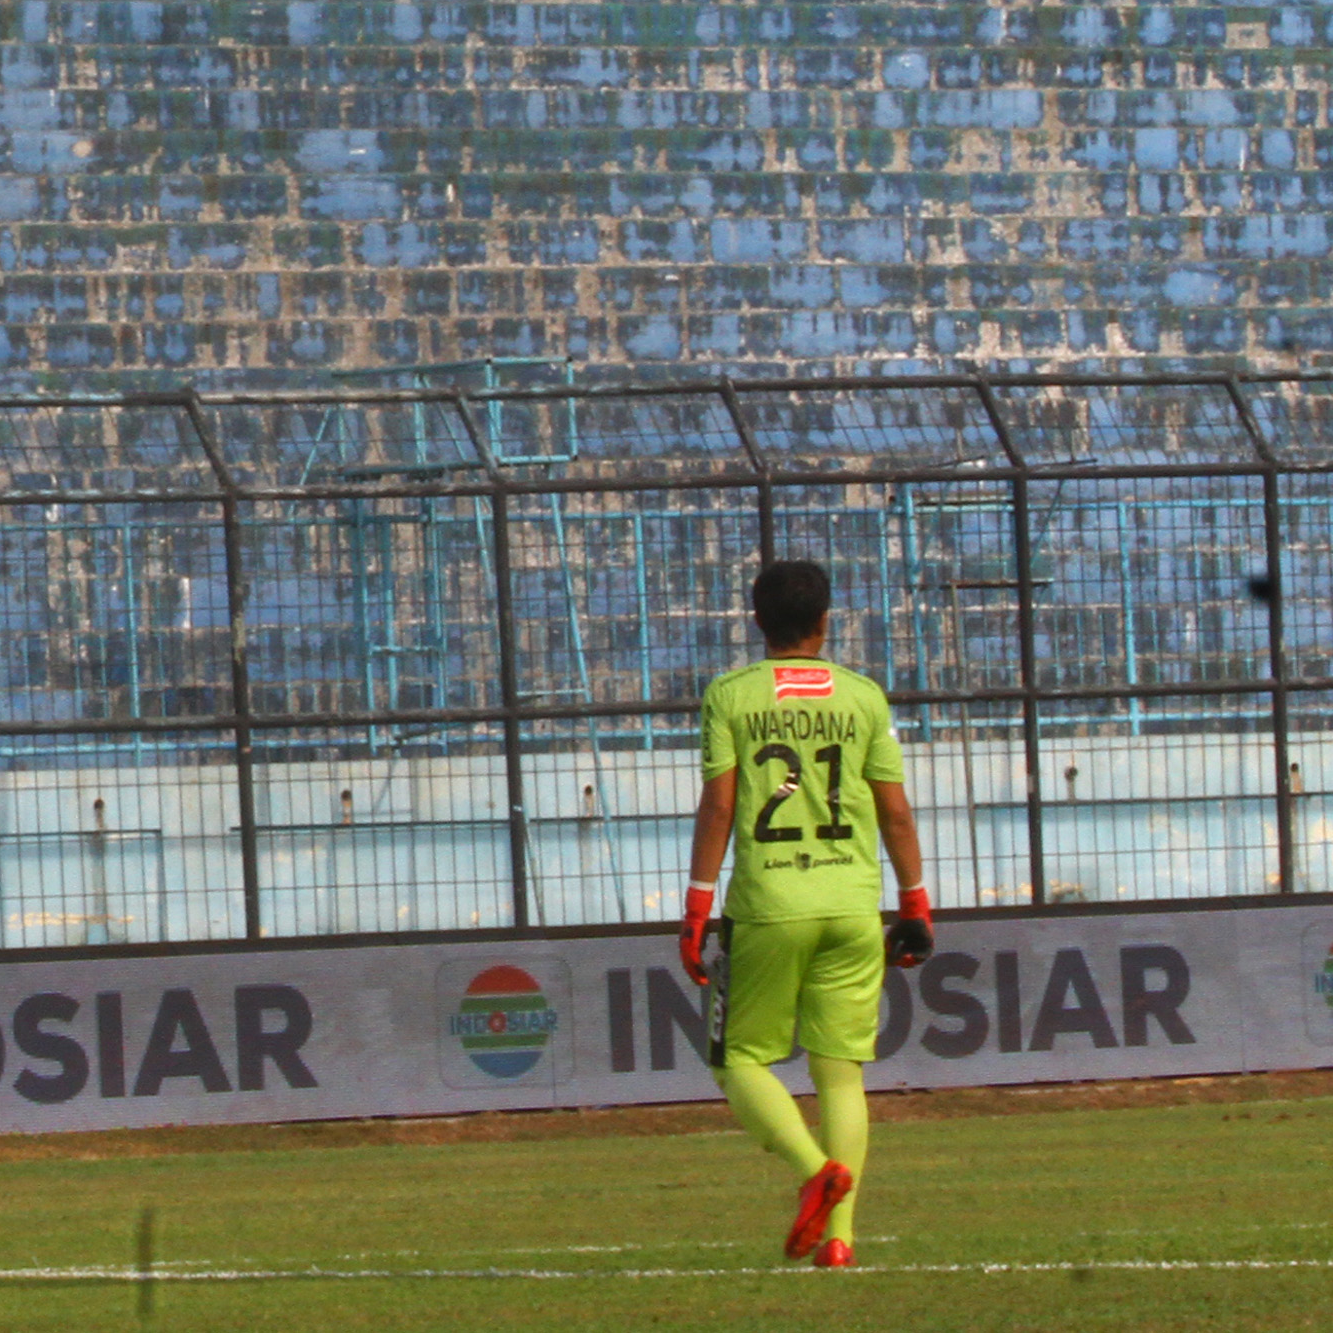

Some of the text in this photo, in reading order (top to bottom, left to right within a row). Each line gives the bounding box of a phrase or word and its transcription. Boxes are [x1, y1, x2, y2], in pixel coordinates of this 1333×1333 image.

[746, 710, 857, 743] WARDANA
[753, 743, 853, 843] 21
[608, 944, 1197, 1074] INSIAR
